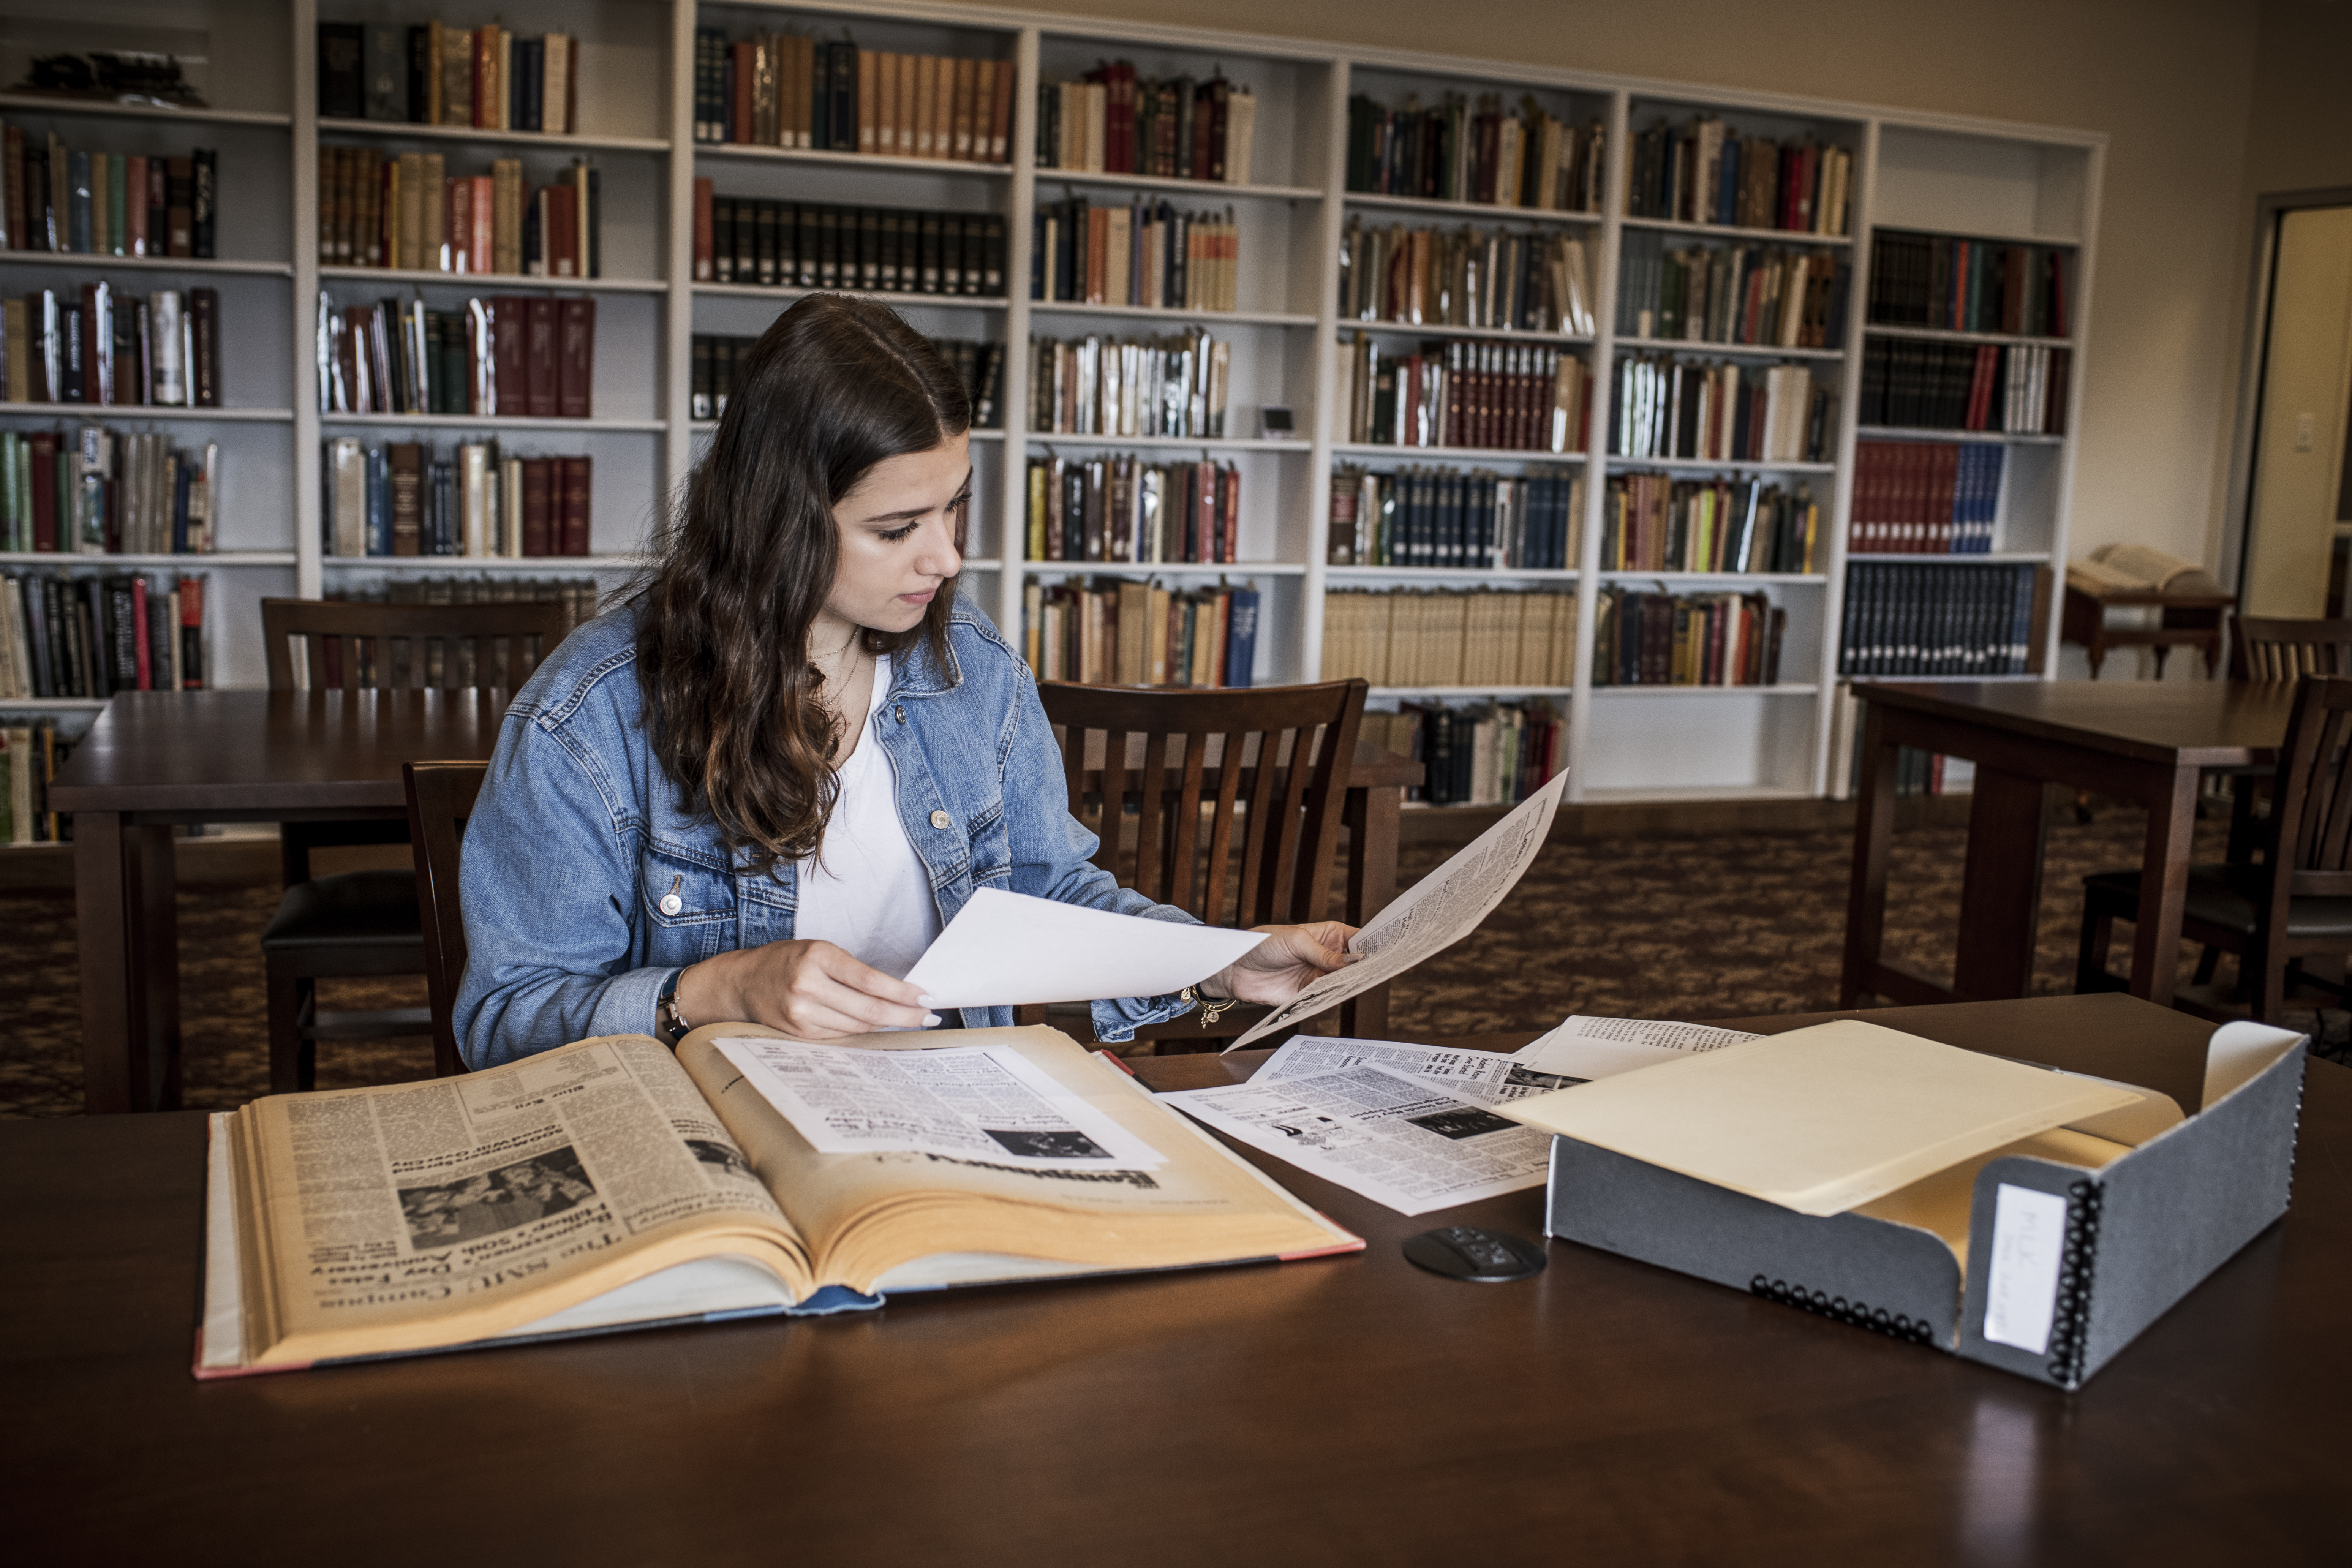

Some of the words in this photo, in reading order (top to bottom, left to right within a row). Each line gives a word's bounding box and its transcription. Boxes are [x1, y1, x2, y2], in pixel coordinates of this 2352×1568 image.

[1457, 1064, 1475, 1075] Started
[1464, 1056, 1479, 1065] Drive
[1476, 1057, 1493, 1070] Students
[560, 1231, 623, 1261] The
[310, 1250, 452, 1276] Anniversary
[402, 1262, 452, 1279] Day
[465, 1256, 549, 1294] SMU
[318, 1284, 452, 1310] Campus
